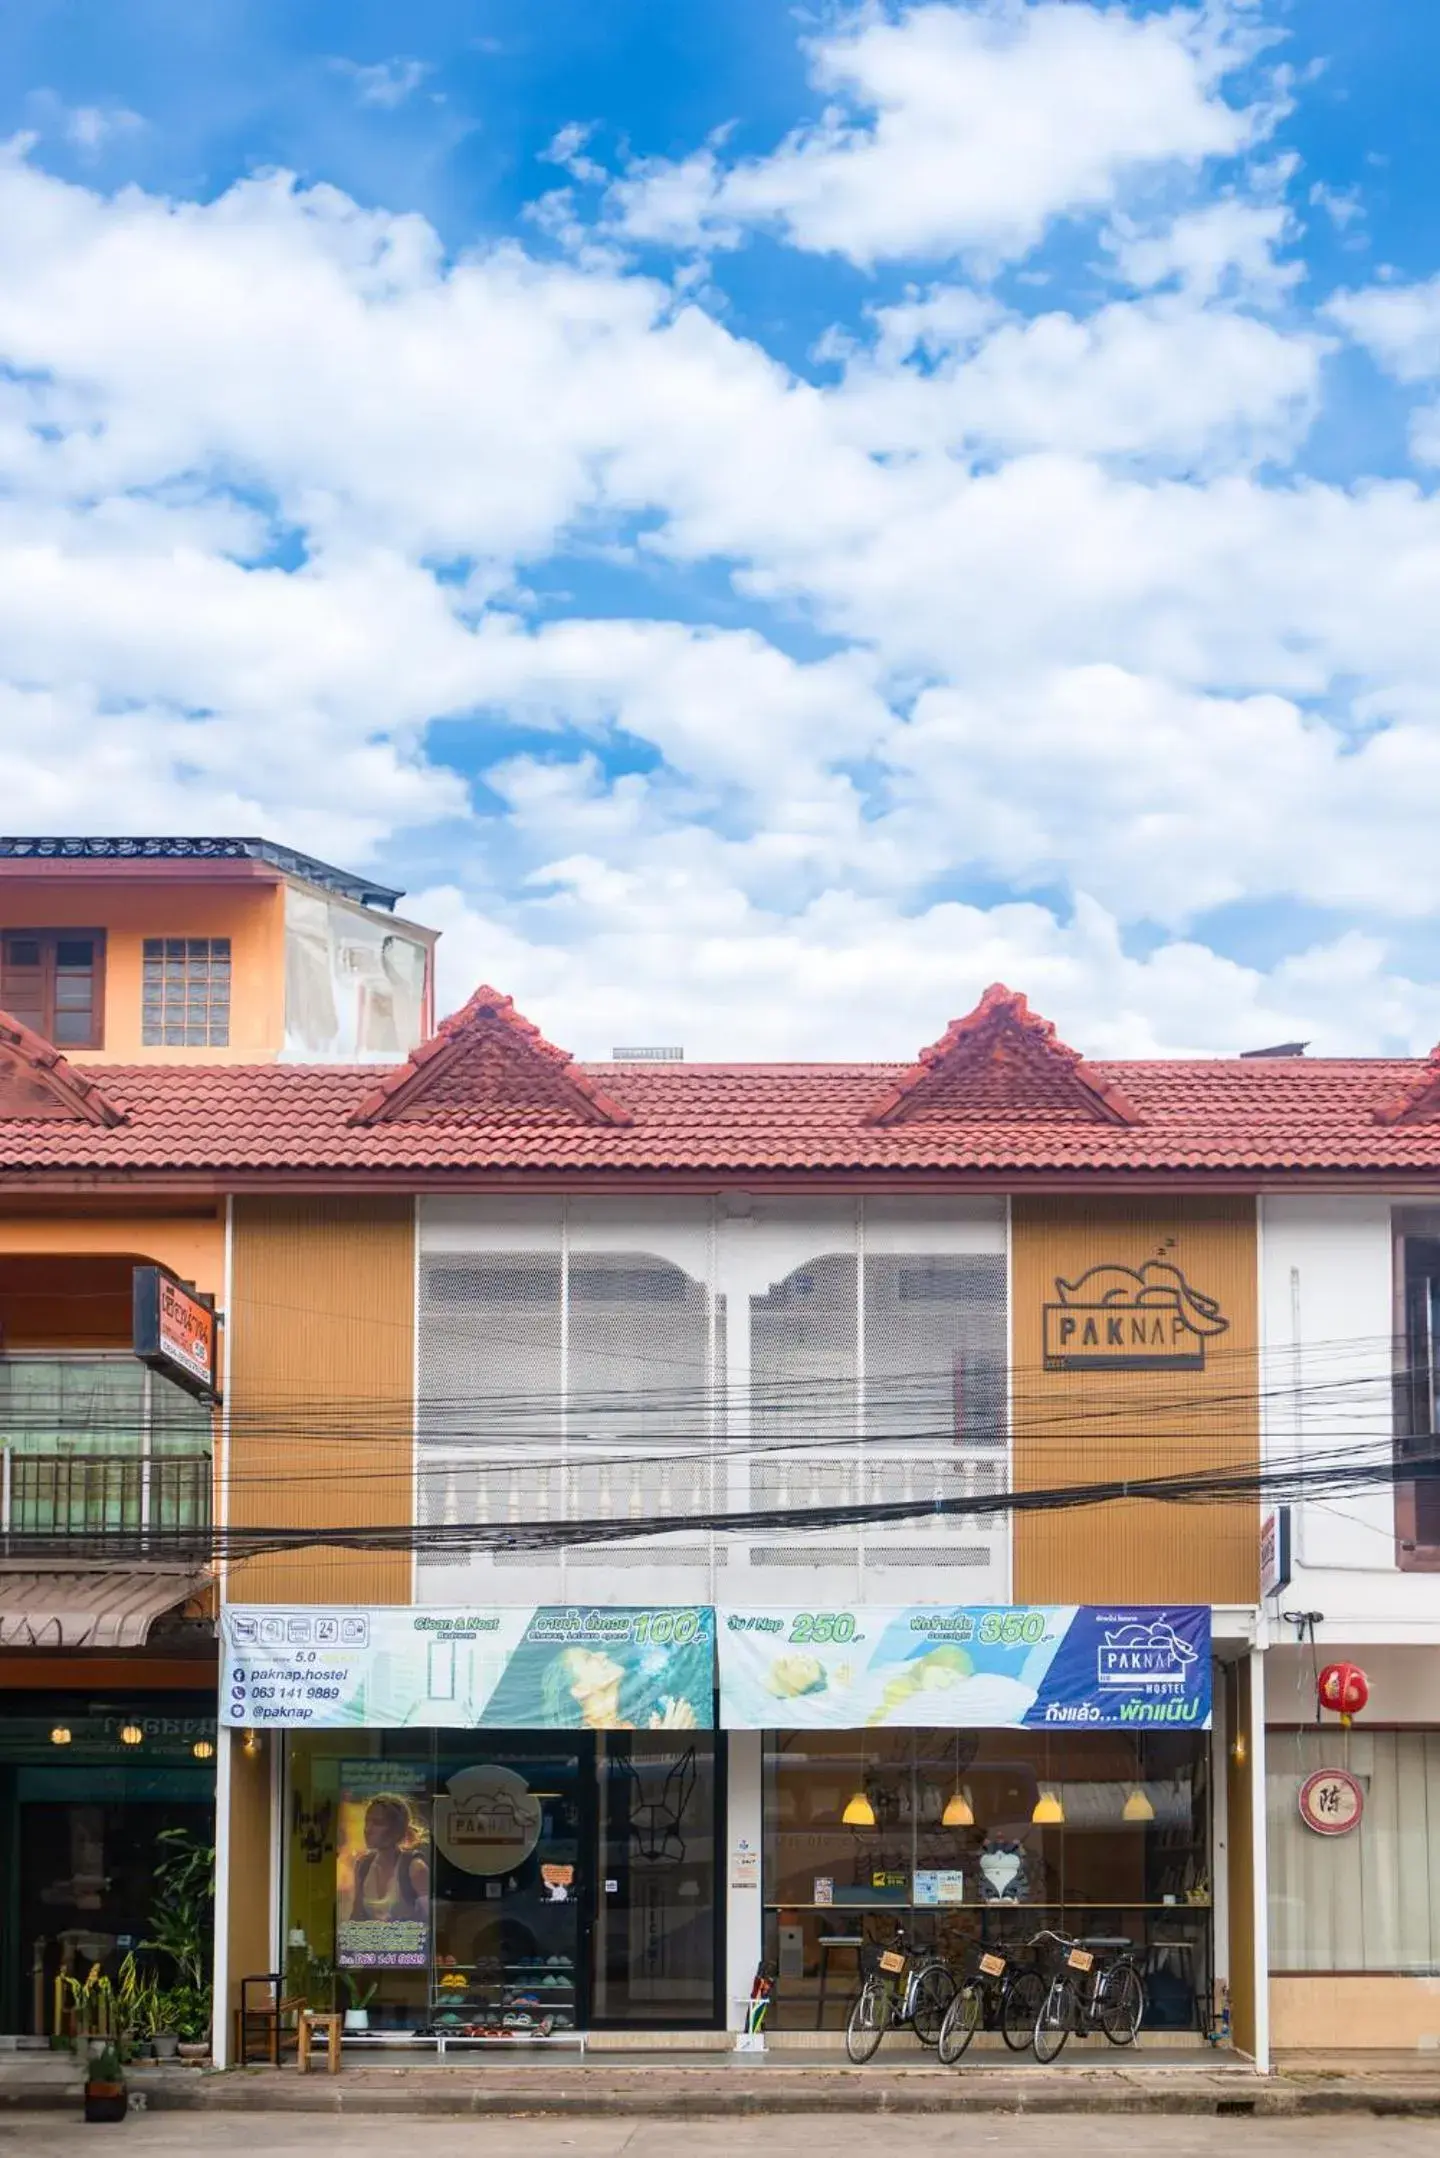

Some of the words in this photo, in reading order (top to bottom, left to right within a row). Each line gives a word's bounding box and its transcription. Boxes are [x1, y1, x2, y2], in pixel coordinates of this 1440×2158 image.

[1060, 1317, 1186, 1345] PAKNAP
[319, 1621, 334, 1634] 24
[414, 1616, 453, 1630] Clean
[454, 1617, 466, 1630] &
[466, 1617, 500, 1630] Neat
[755, 1617, 784, 1633] Nap
[294, 1651, 317, 1663] 5.0
[1108, 1653, 1176, 1669] PAKNAP
[250, 1668, 348, 1682] paknap.hostel
[251, 1687, 275, 1699] 063
[280, 1687, 302, 1699] 141
[305, 1687, 340, 1699] 9889
[1146, 1683, 1186, 1694] HOSTEL
[252, 1705, 313, 1719] @paknap
